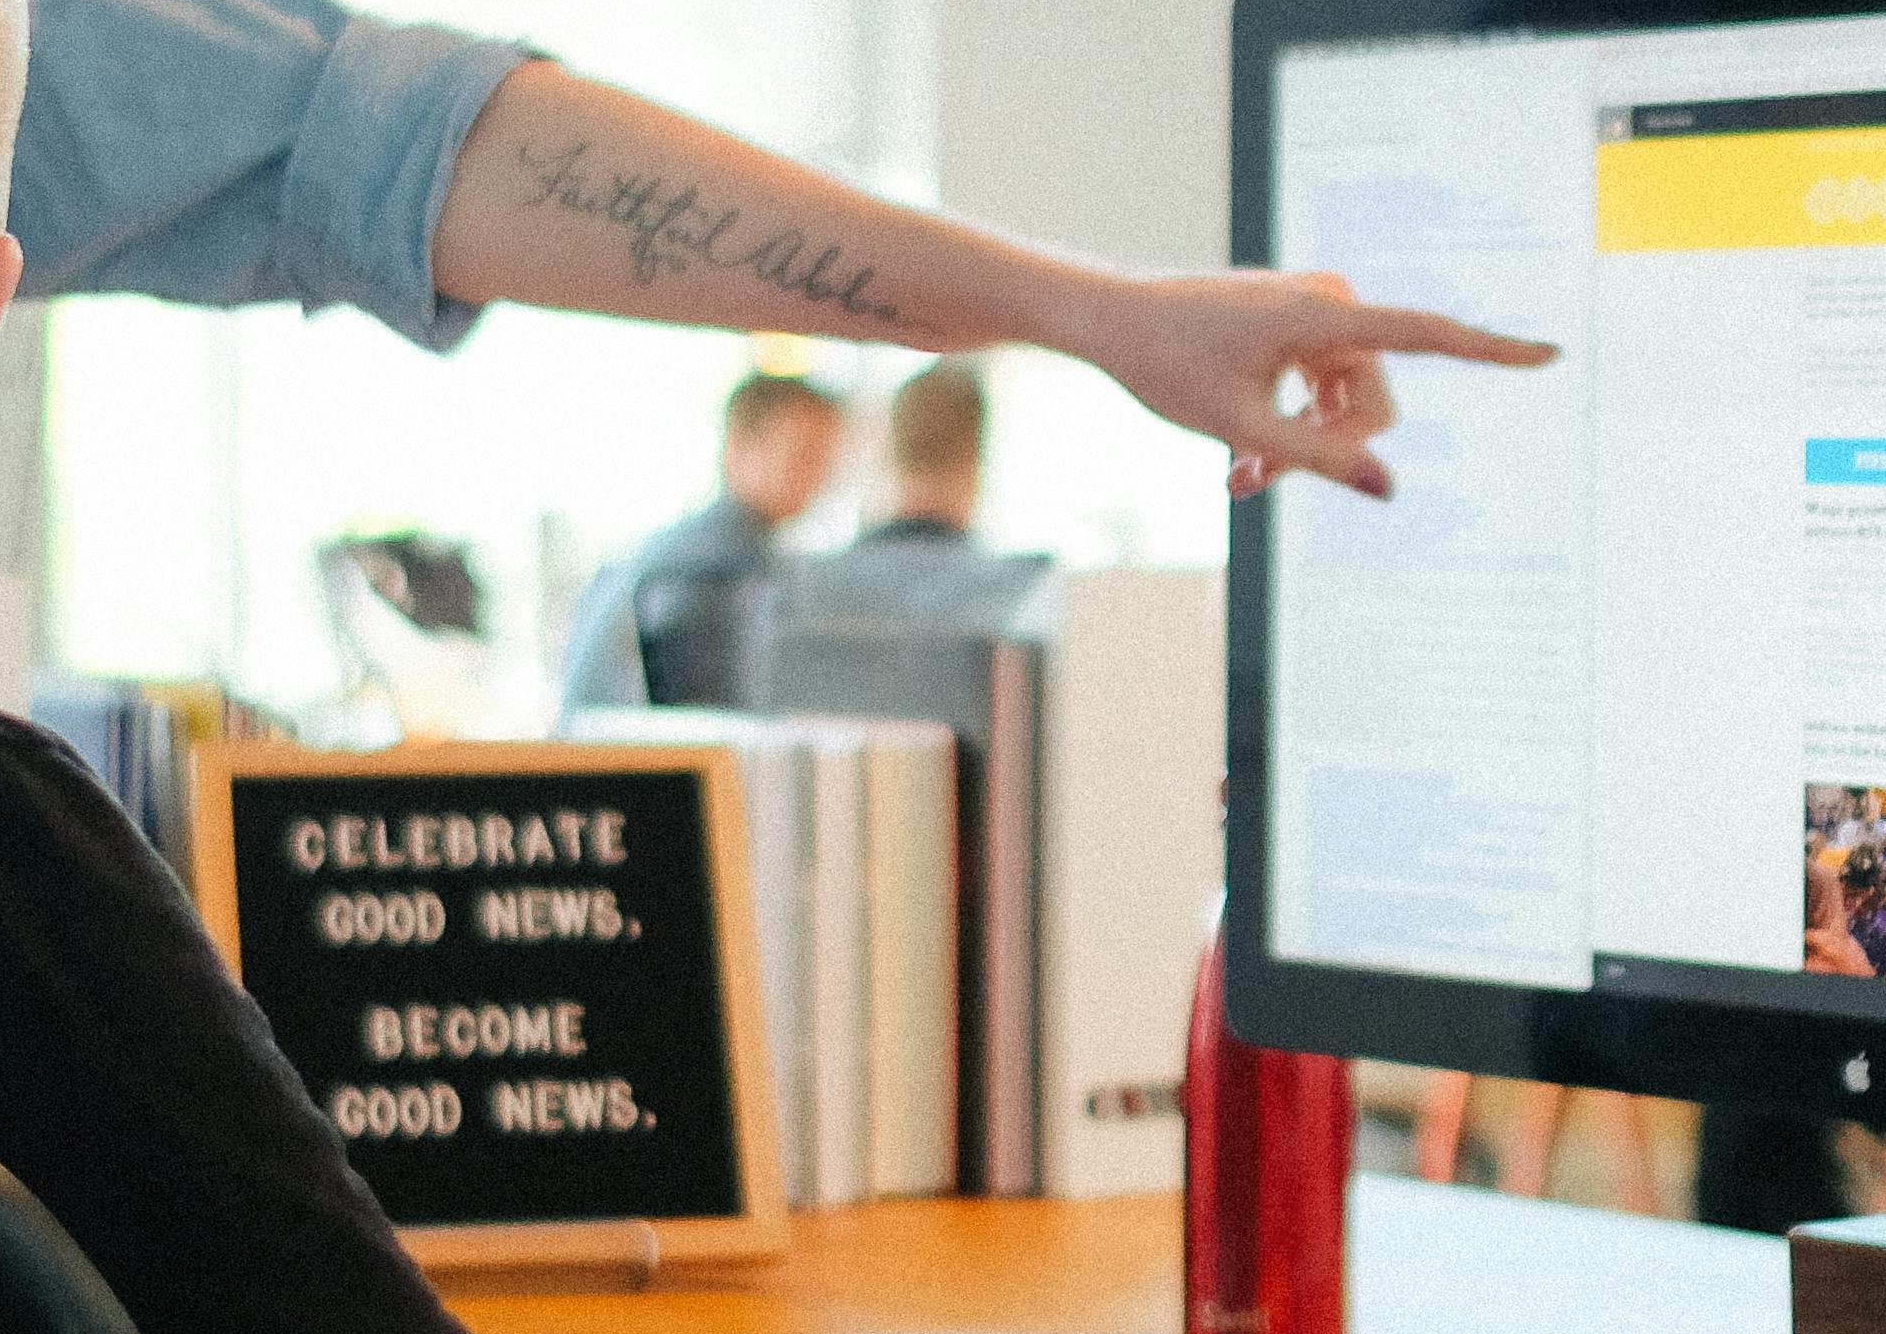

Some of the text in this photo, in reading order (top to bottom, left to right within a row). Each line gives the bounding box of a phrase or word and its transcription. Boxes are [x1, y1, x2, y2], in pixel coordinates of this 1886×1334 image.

[290, 810, 629, 871] CELEBRATE
[320, 885, 642, 944] GOOD NEWS.
[367, 1002, 587, 1060] BECOME
[330, 1076, 657, 1138] GOOD NEWS.
